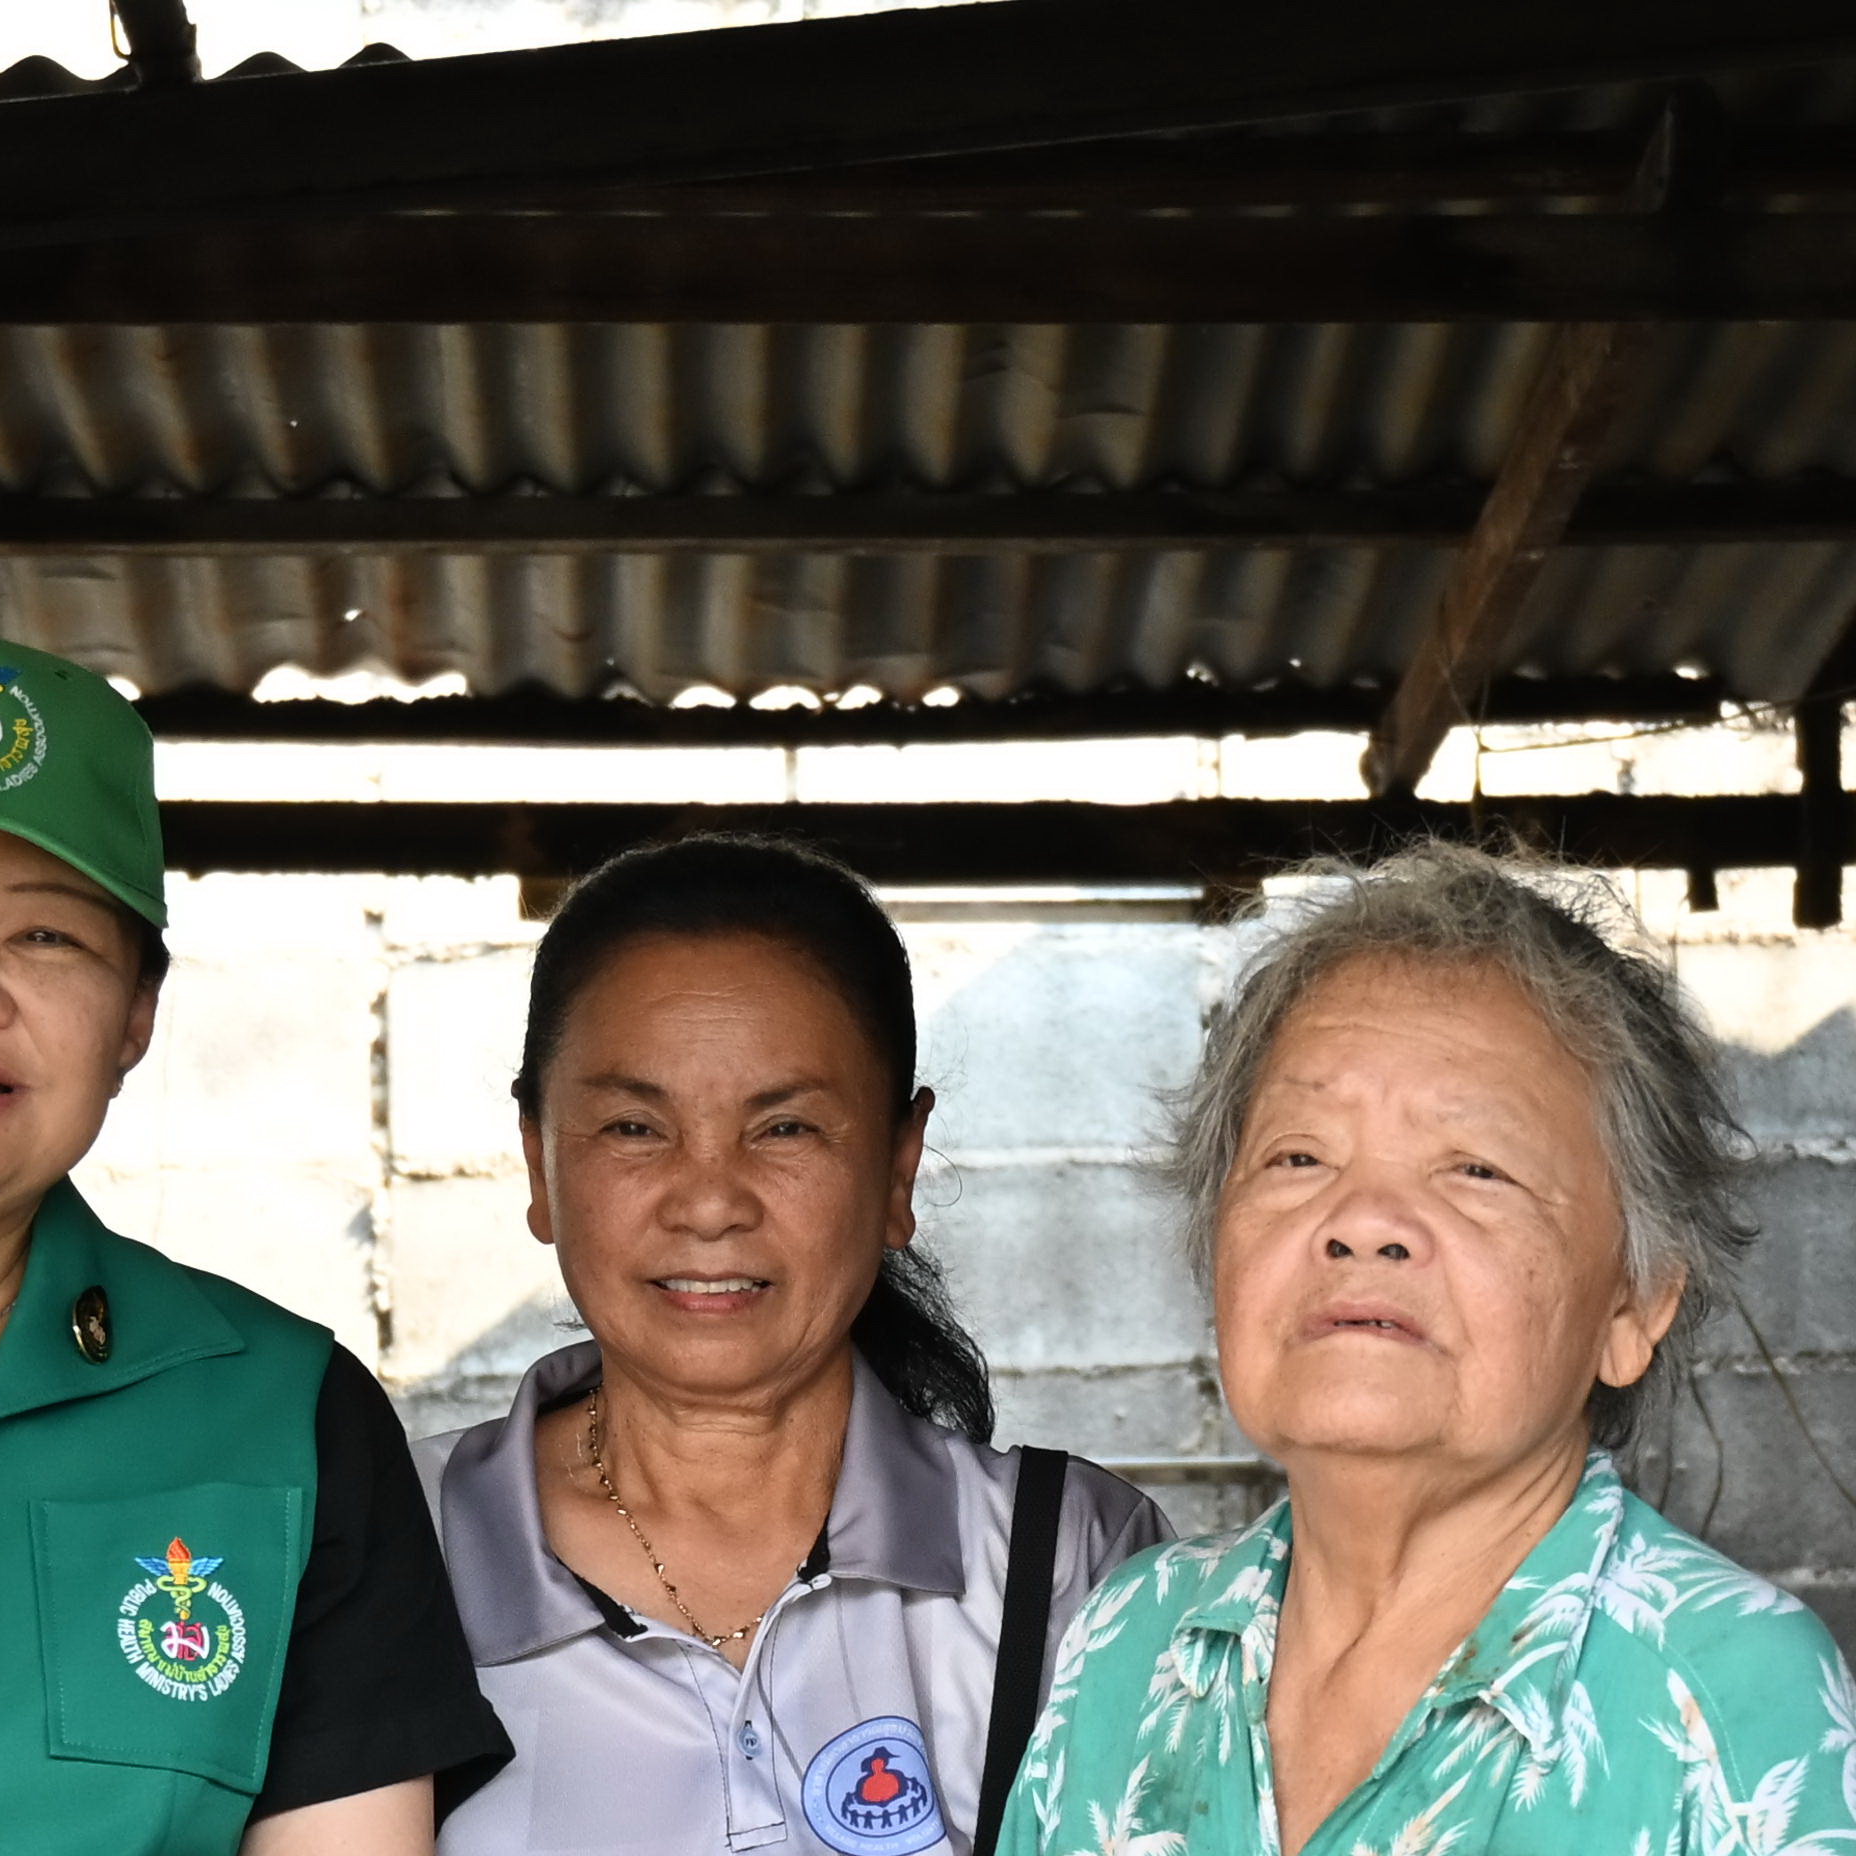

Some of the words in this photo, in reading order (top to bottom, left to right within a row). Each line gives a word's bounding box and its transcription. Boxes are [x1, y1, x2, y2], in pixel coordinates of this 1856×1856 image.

[118, 1577, 158, 1618] PUBLIC
[117, 1618, 145, 1665] HEALTH
[206, 1581, 247, 1664] ASSOCIATION
[207, 1658, 241, 1697] LADIES
